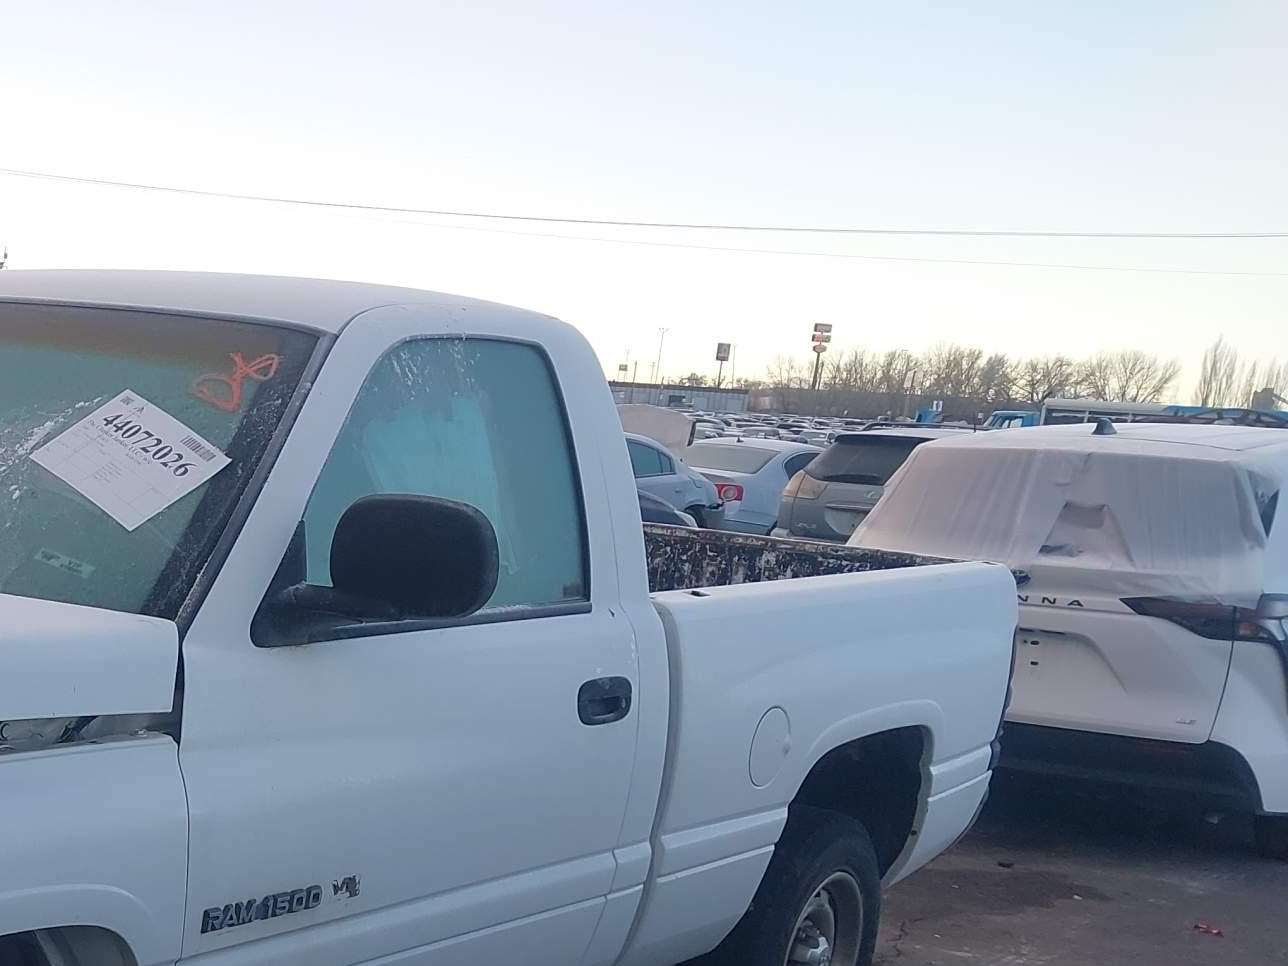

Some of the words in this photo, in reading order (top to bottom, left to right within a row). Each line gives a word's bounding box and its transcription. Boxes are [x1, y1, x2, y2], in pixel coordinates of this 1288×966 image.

[103, 414, 198, 477] 44072026
[201, 899, 257, 934] RAM
[259, 885, 323, 920] 1500
